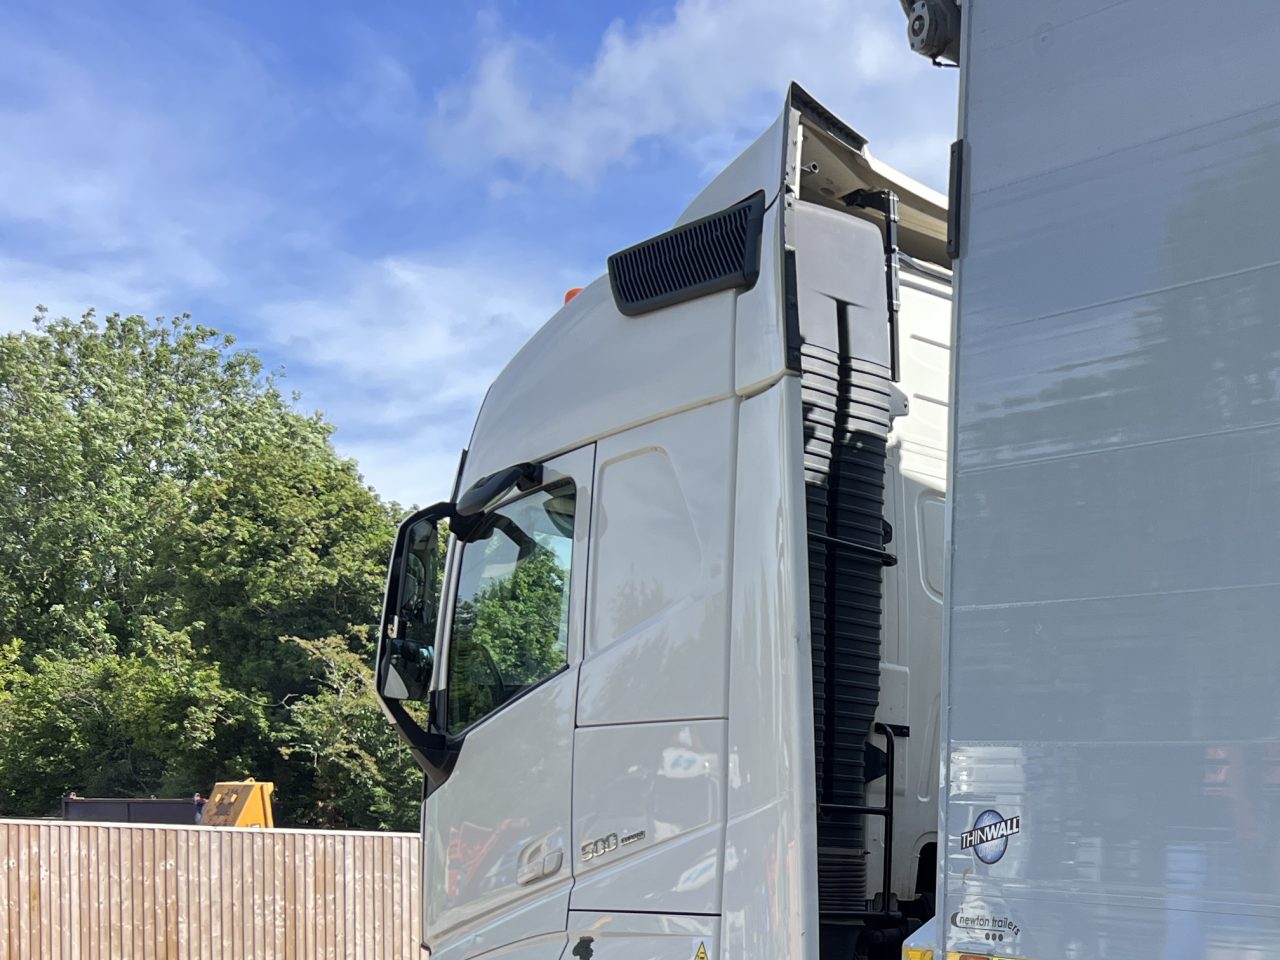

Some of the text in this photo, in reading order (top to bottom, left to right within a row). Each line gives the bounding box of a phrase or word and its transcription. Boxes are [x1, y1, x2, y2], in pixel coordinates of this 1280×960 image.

[581, 832, 618, 862] 500
[961, 818, 1019, 849] THINWALL
[959, 915, 1020, 936] newton trailers
